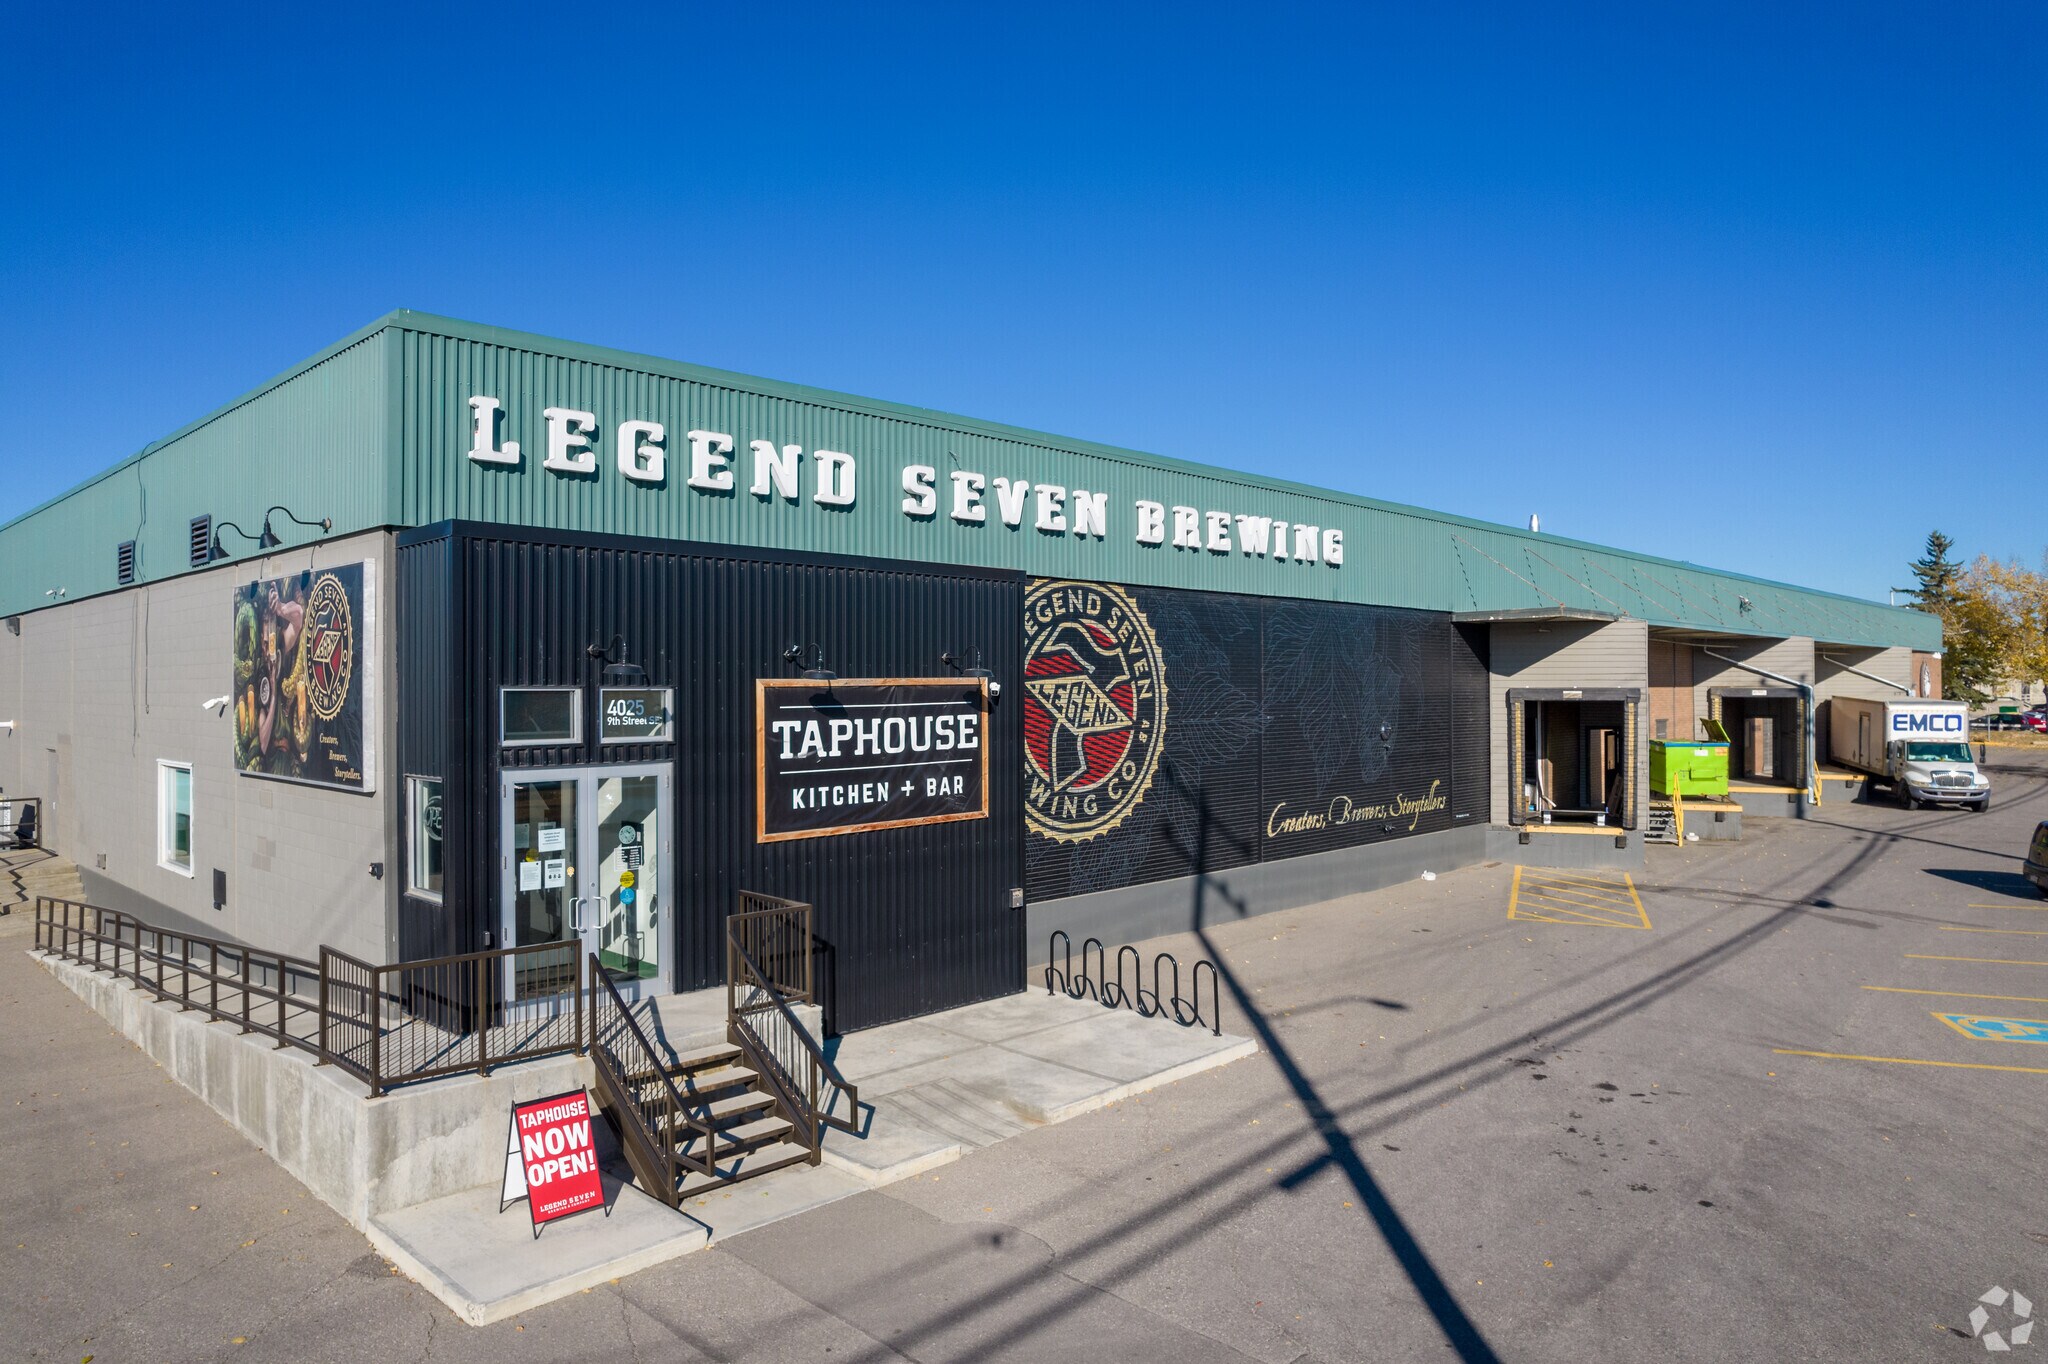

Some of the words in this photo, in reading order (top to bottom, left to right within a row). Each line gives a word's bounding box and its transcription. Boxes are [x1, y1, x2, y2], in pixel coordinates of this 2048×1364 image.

[468, 395, 856, 506] LEGEND
[902, 465, 1108, 537] SEVEN
[1136, 500, 1343, 565] BREWING
[324, 586, 344, 616] SEVEN
[1025, 589, 1101, 647] EGEND
[1107, 607, 1153, 700] SEVEN
[607, 699, 644, 716] 4025
[607, 716, 620, 726] 9th
[622, 716, 647, 726] Street
[1893, 714, 1962, 732] EMCO
[772, 714, 978, 759] TAPHOUSE
[792, 781, 889, 809] KITCHEN
[901, 780, 915, 796] +
[926, 775, 964, 797] BAR
[1267, 802, 1326, 838] Creators,
[1328, 795, 1387, 825] Brewers,
[520, 1100, 587, 1129] TAPHOUSE
[523, 1120, 589, 1161] NOW
[527, 1149, 596, 1187] OPEN!
[540, 1199, 568, 1212] LEGEND
[568, 1191, 596, 1204] SEVEN
